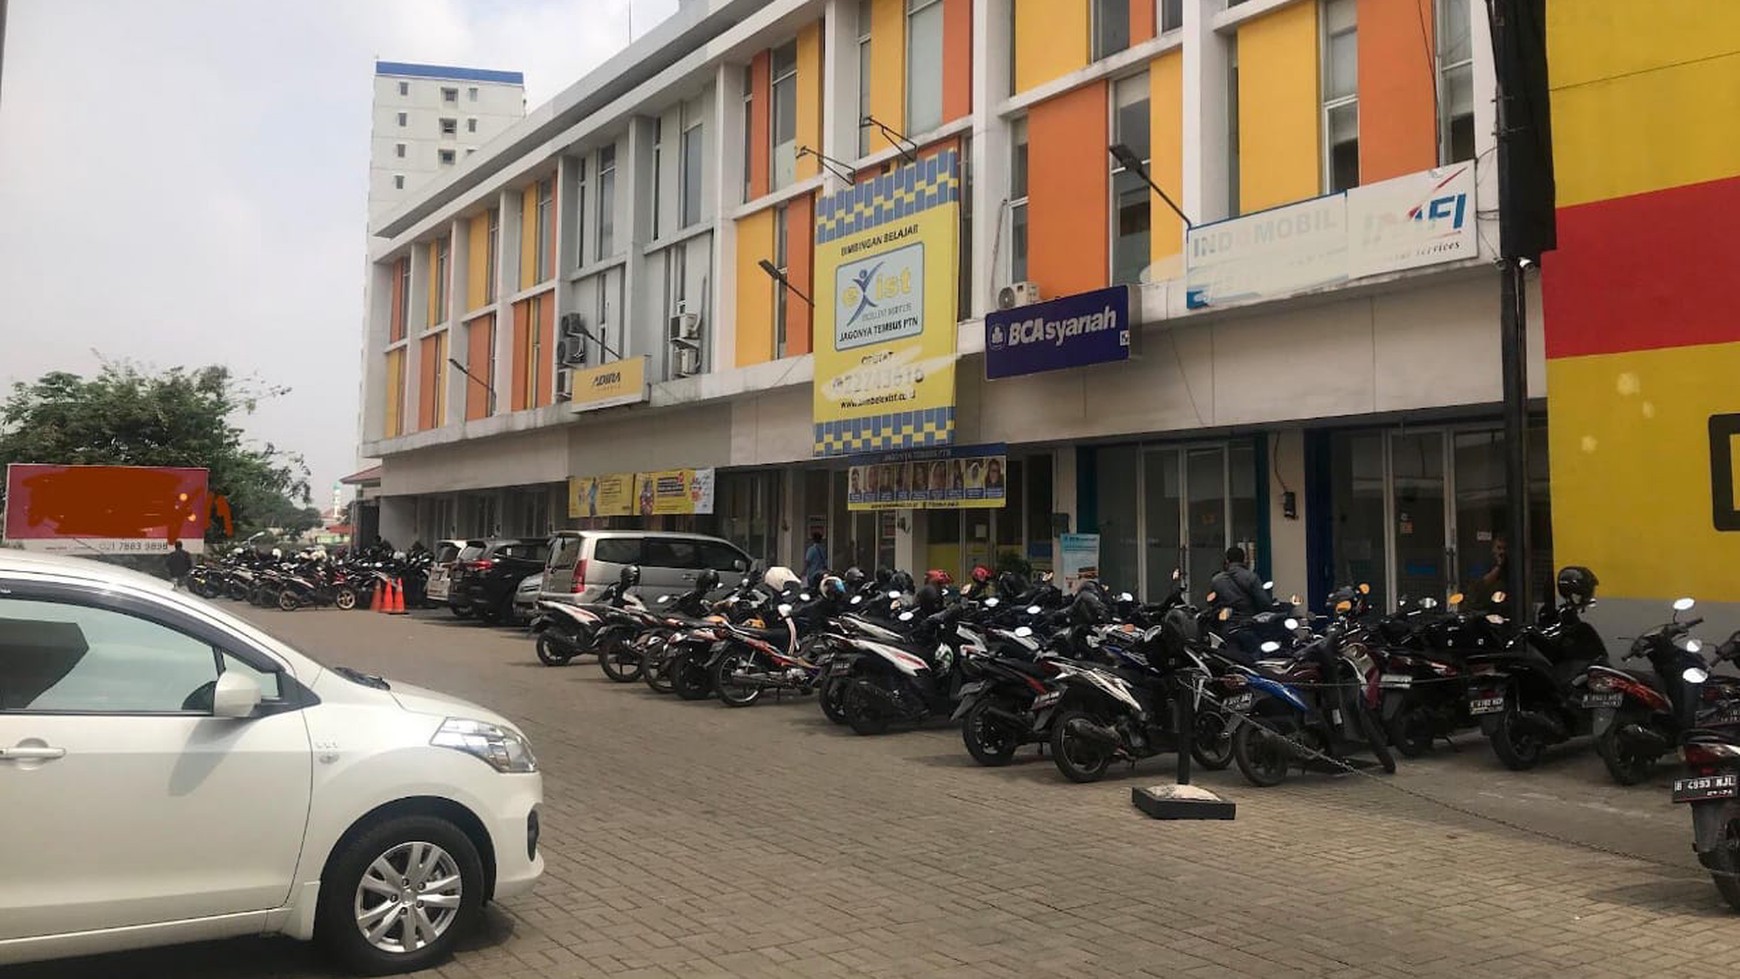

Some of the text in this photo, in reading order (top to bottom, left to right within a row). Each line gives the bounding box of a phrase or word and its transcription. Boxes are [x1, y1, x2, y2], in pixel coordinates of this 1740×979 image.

[841, 224, 919, 256] BIMBINGAN BELAJAR
[839, 316, 919, 342] JAGONYA TEMBUS PTN
[1008, 305, 1117, 347] BCA syariah
